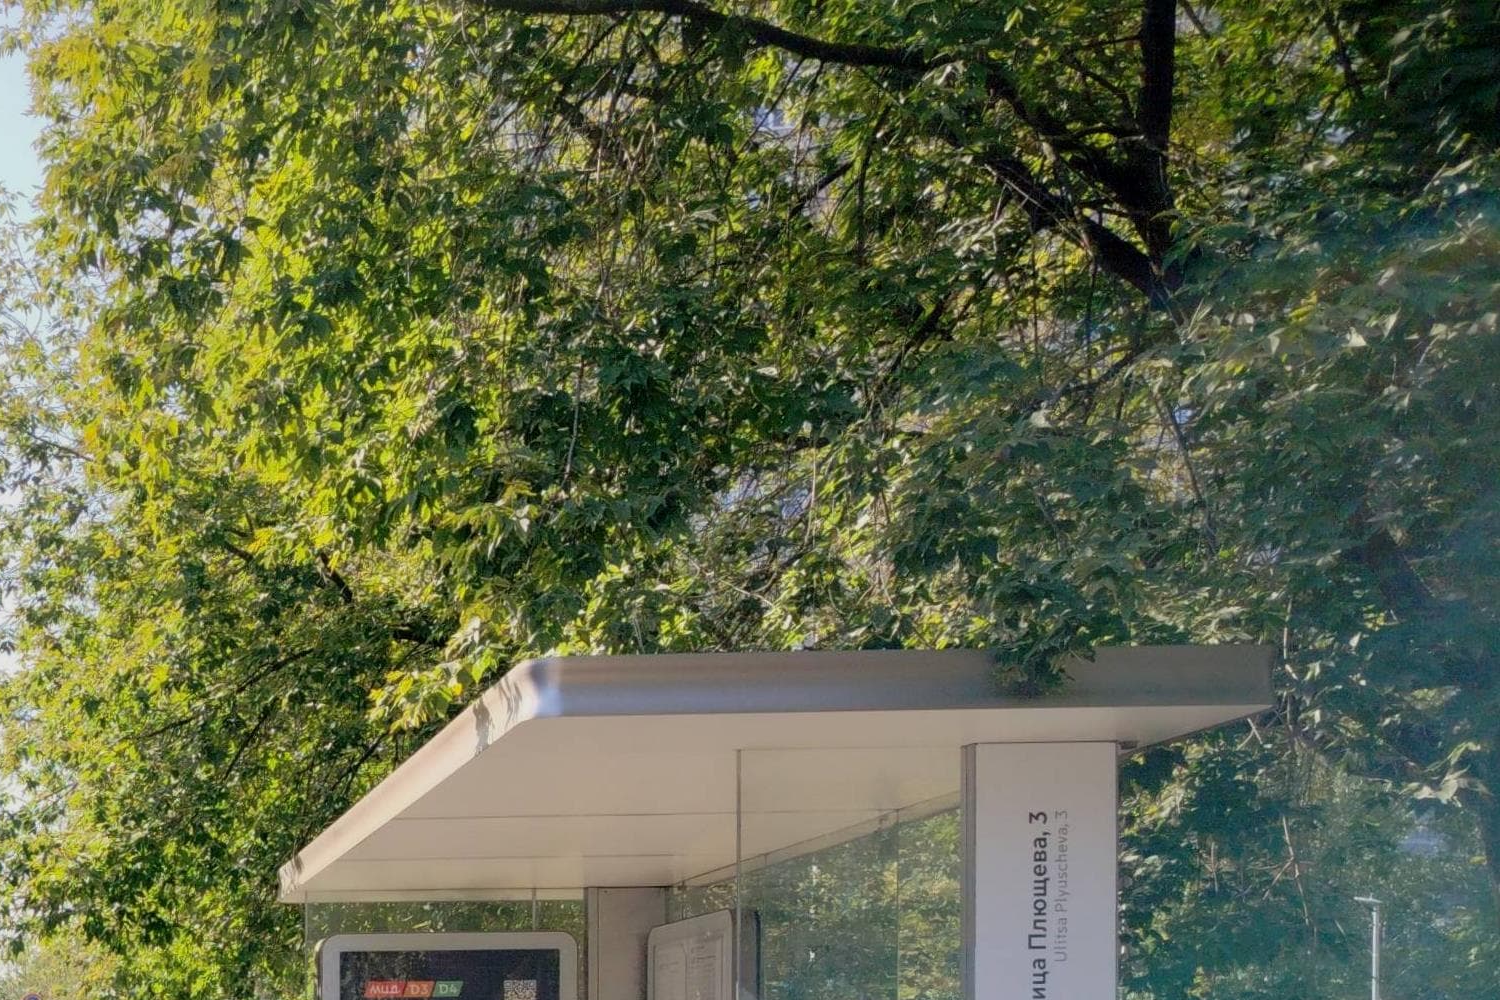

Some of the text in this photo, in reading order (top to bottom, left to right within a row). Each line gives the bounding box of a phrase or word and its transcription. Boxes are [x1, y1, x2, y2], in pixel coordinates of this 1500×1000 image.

[1028, 811, 1048, 825] 3
[1027, 831, 1052, 949] Плющева,
[1053, 810, 1071, 962] Ulitsa Plyuscheva, 3
